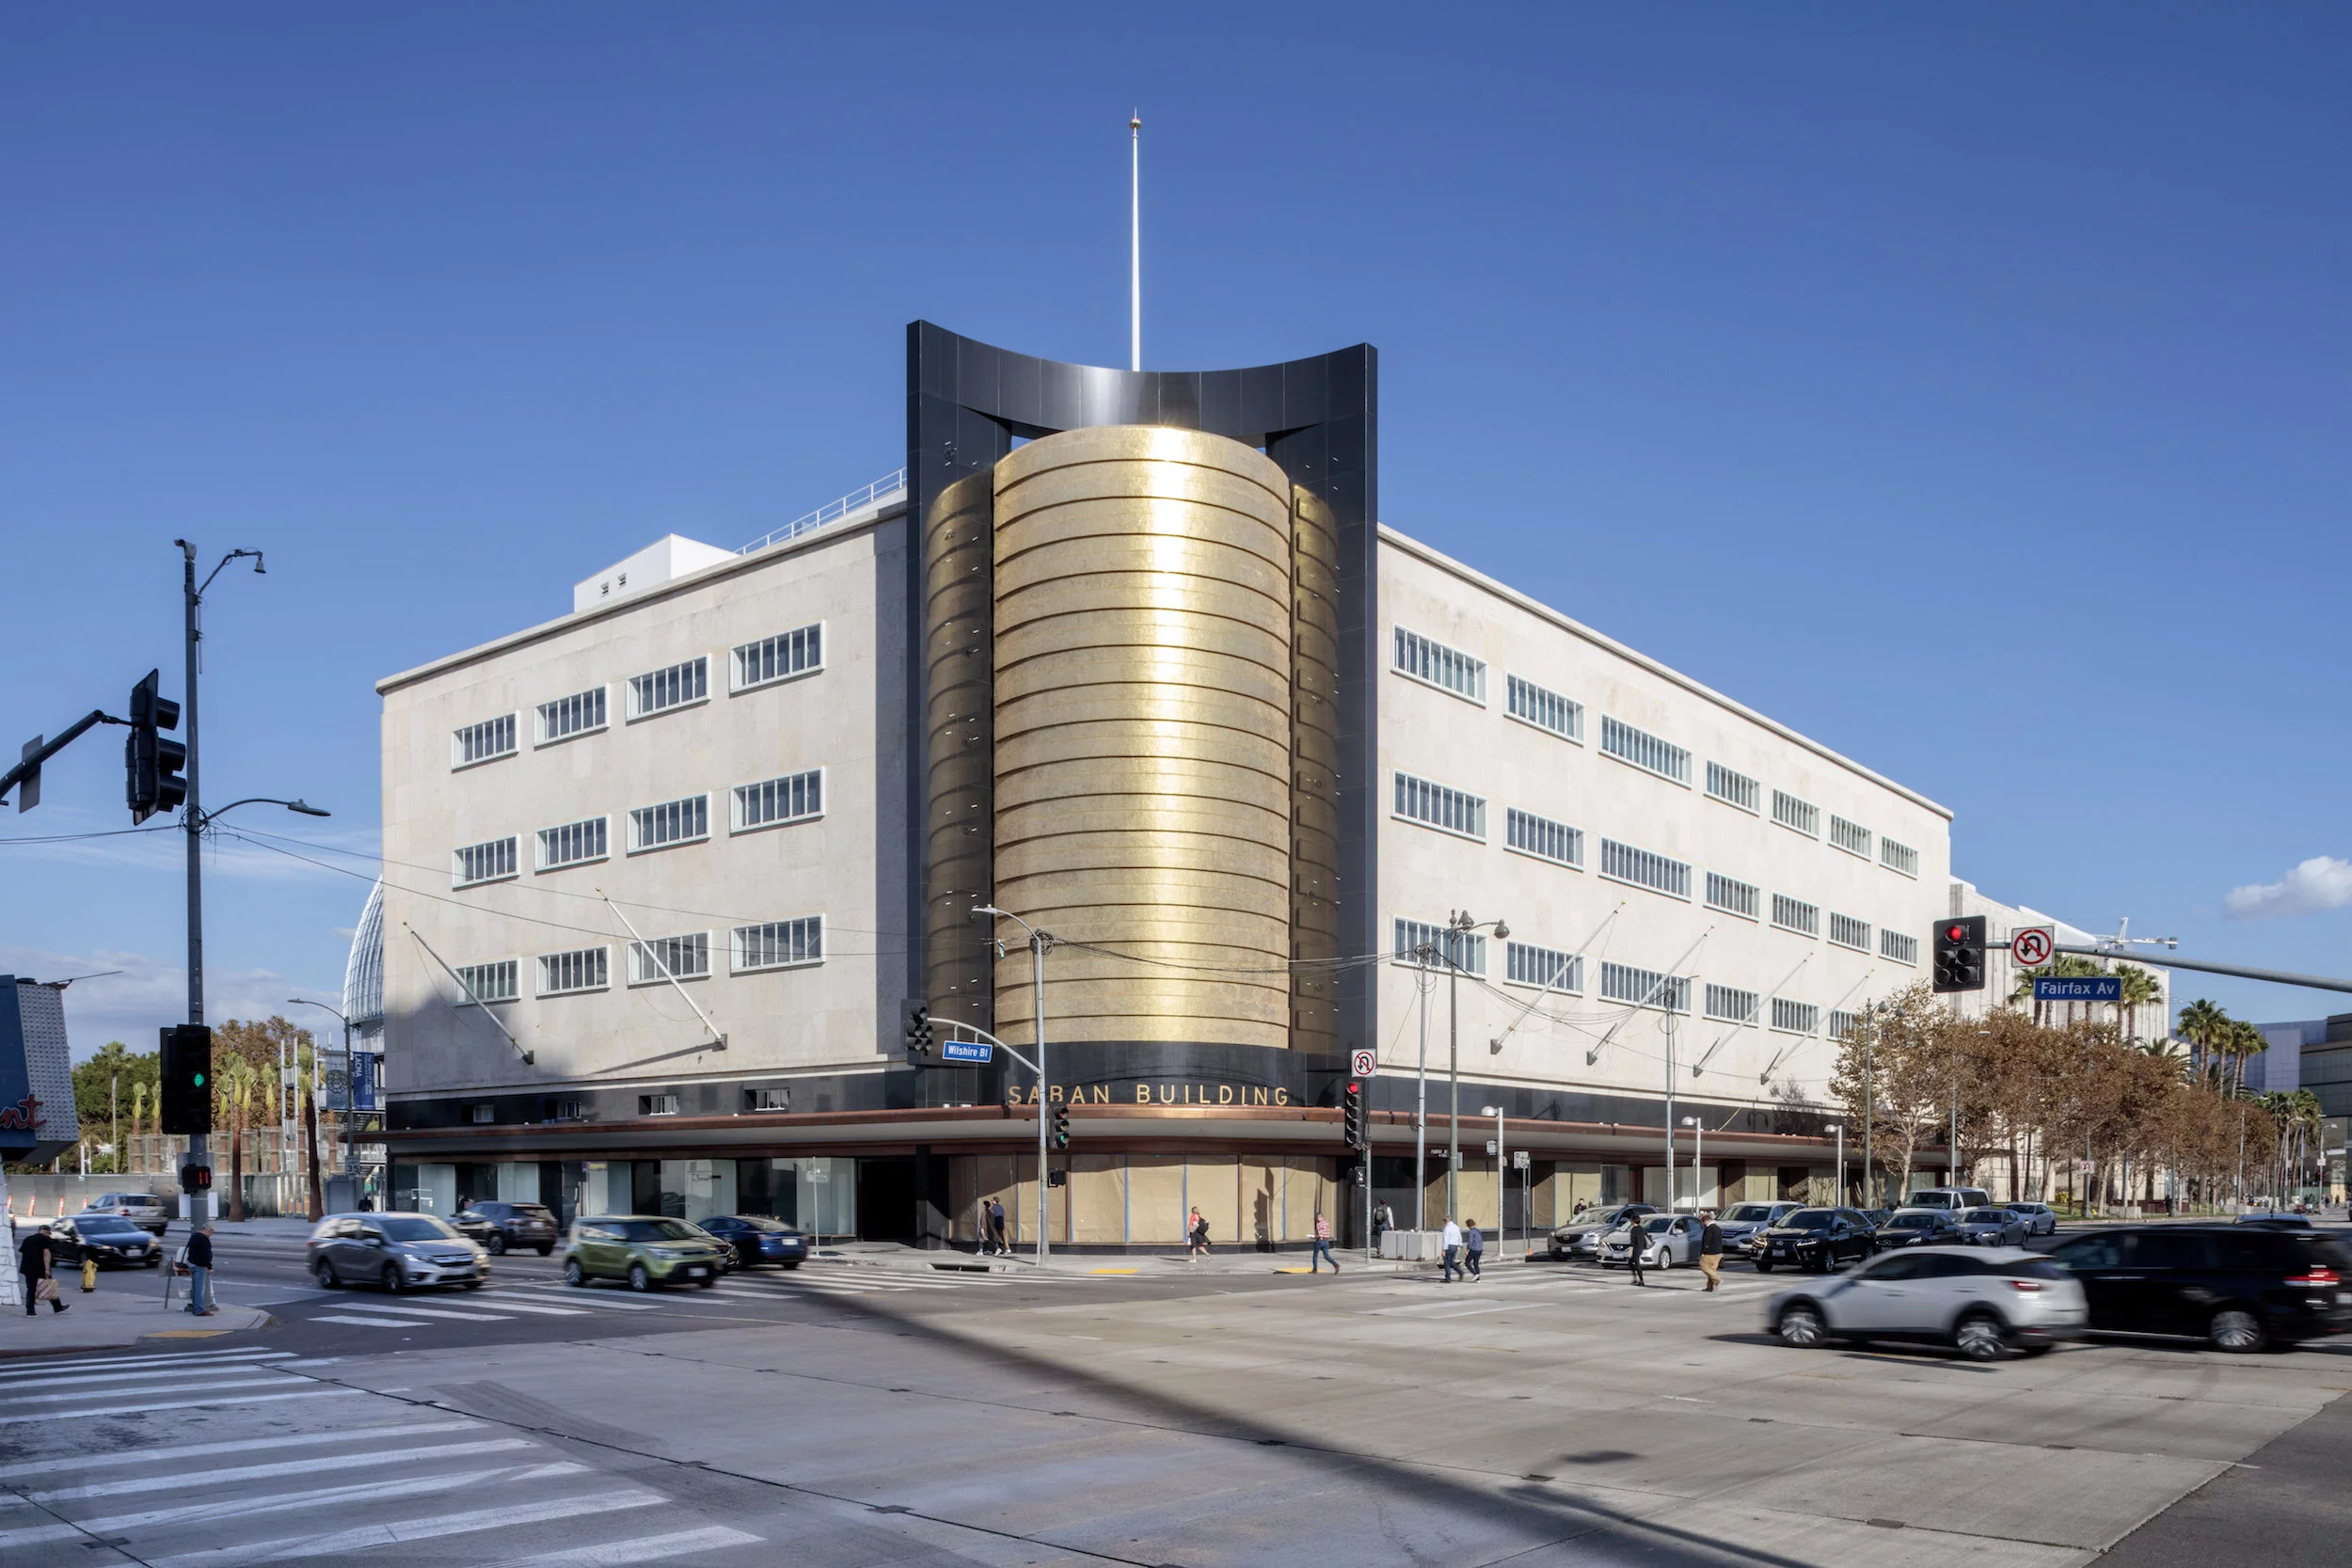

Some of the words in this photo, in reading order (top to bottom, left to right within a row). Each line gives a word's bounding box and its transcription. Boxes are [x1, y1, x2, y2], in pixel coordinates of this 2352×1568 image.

[2041, 981, 2090, 995] Fairfax
[2096, 981, 2116, 995] Av
[947, 1045, 978, 1057] Wilshire
[979, 1047, 989, 1058] Bl
[355, 1053, 363, 1078] LACMA
[1008, 1084, 1109, 1105] SABAN
[1136, 1084, 1289, 1106] BUILDING
[347, 1164, 359, 1173] 35
